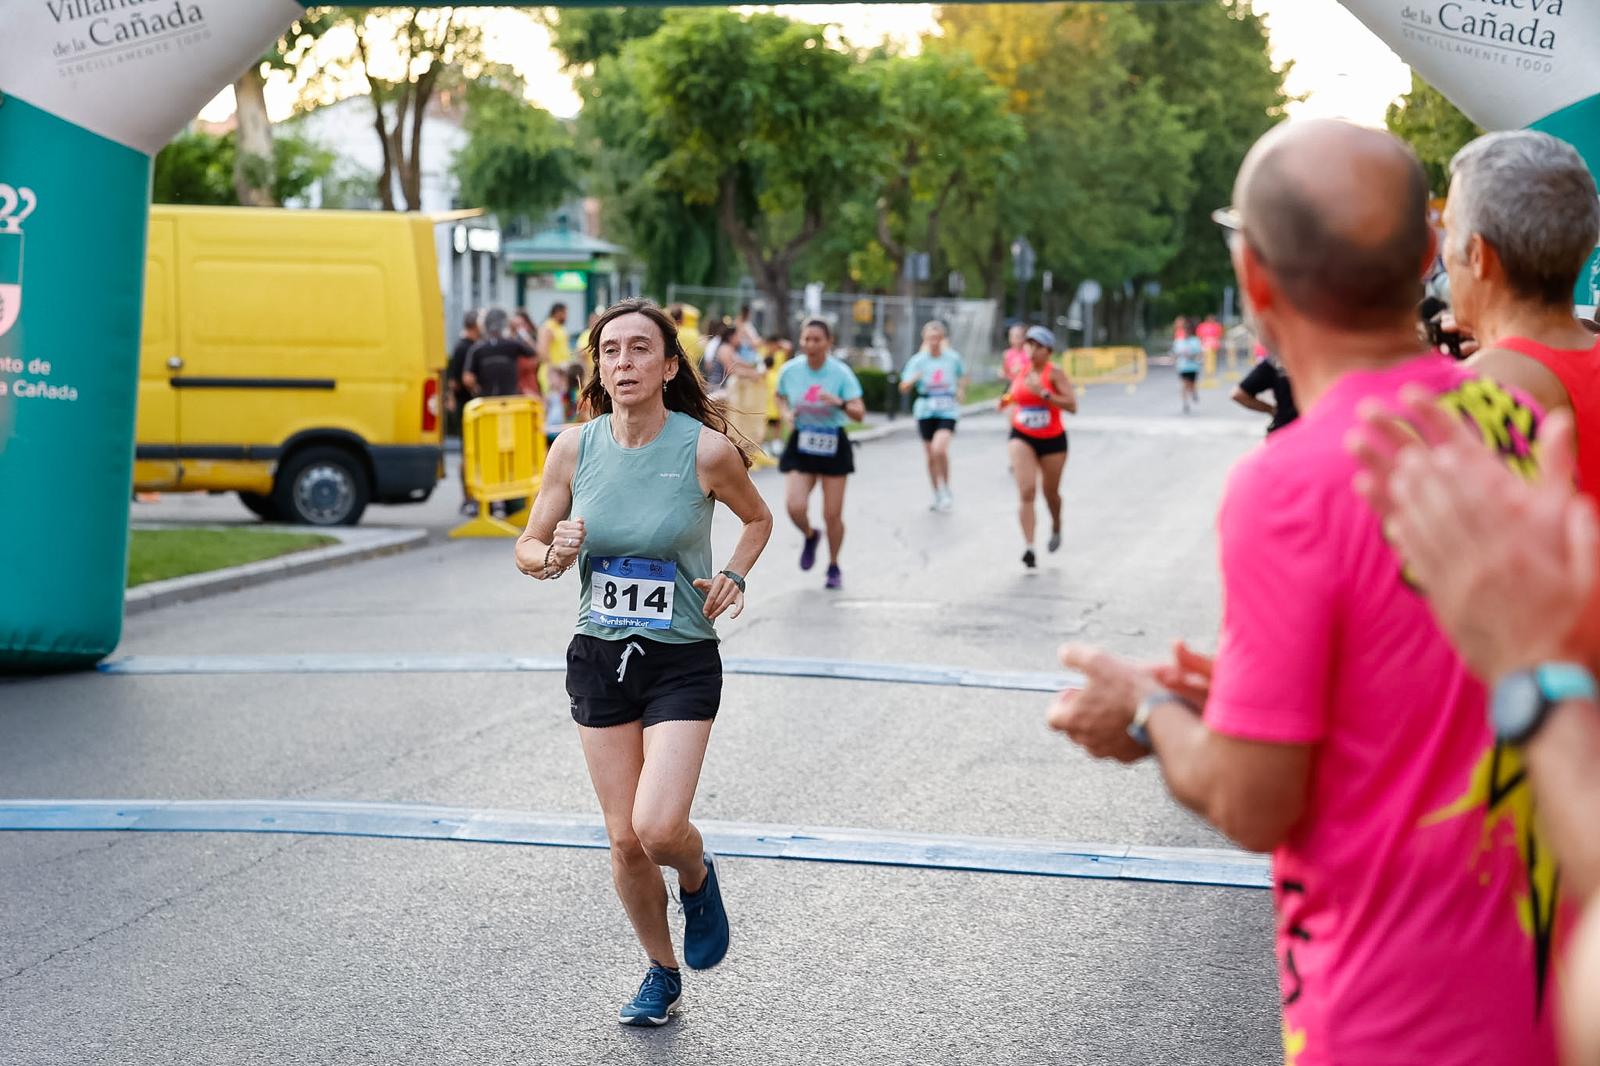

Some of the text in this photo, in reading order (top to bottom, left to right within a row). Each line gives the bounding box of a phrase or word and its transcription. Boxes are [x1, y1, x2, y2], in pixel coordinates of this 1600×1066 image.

[89, 0, 203, 46] Cañada
[1402, 2, 1557, 50] de la Cañada
[1402, 28, 1553, 74] SENCILLAMENTE TODO
[28, 358, 52, 376] de
[13, 379, 78, 401] Cañada
[603, 581, 668, 613] 814
